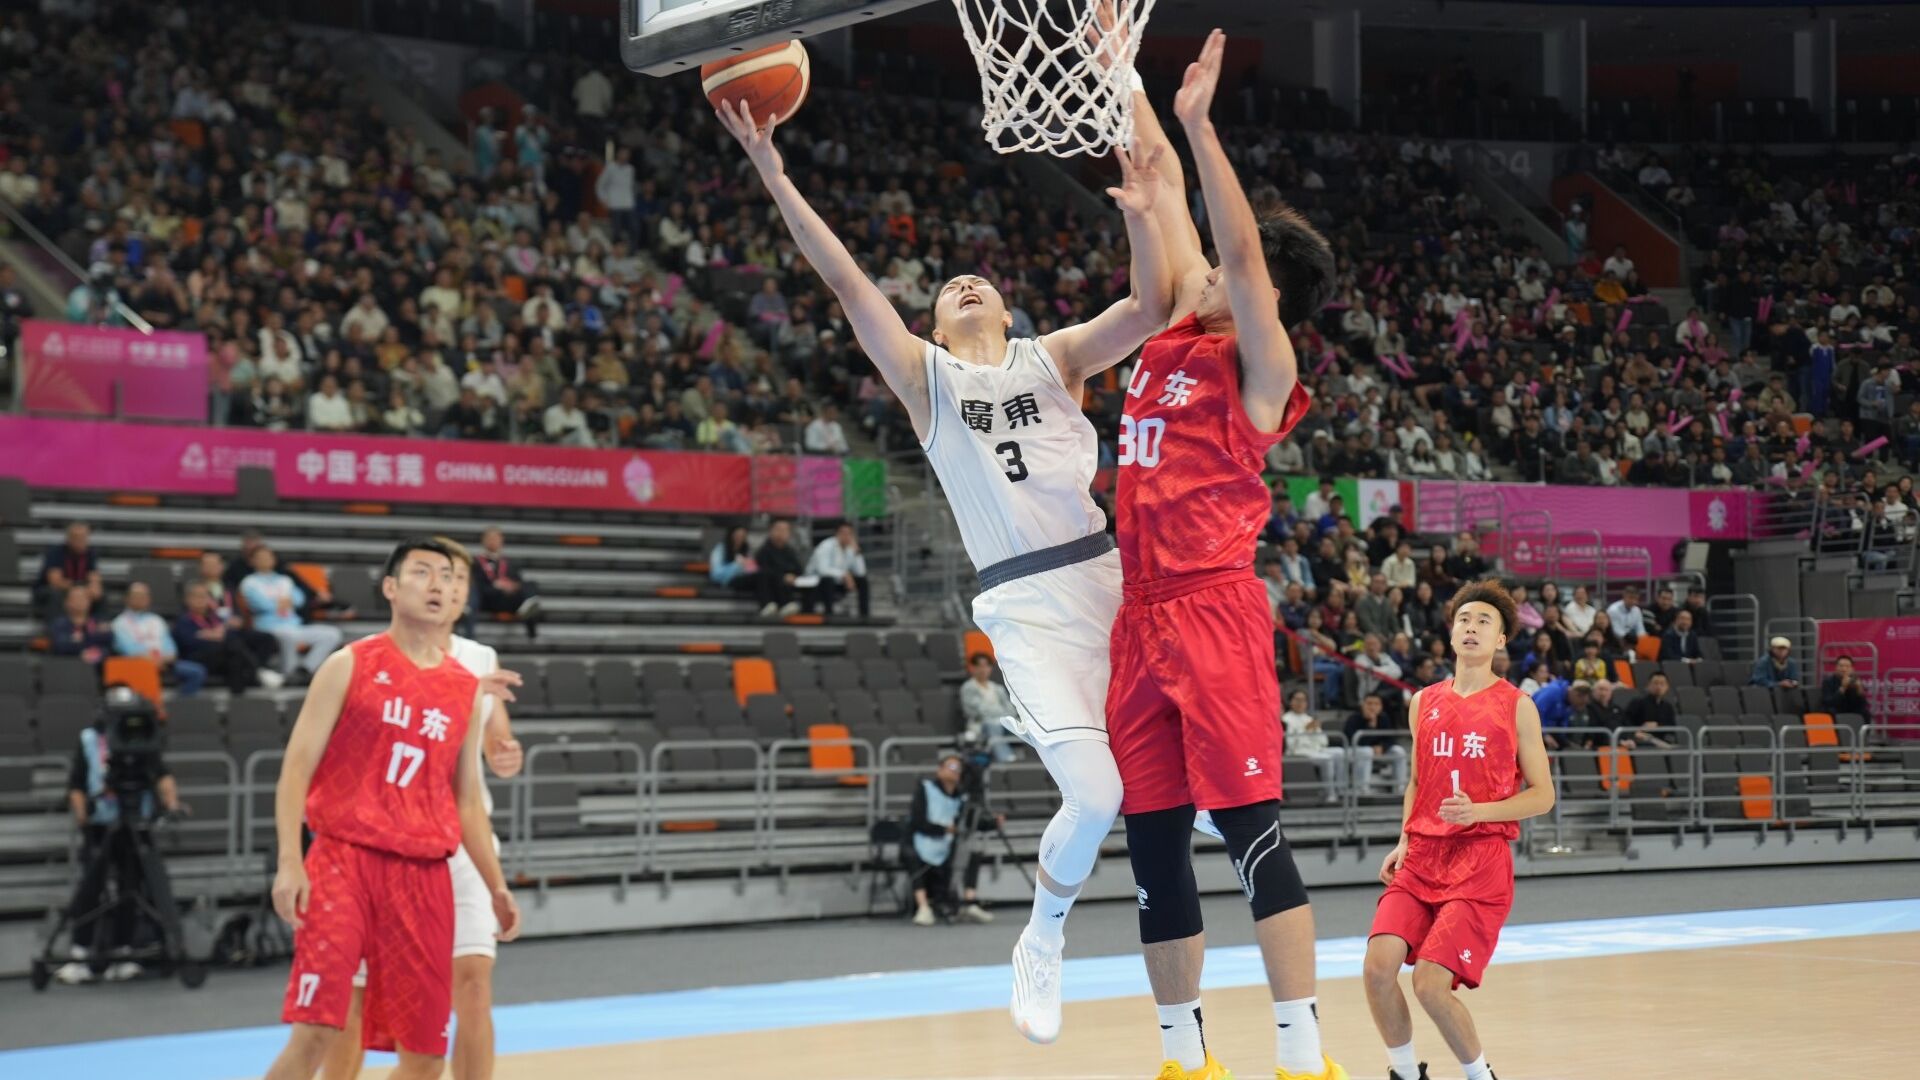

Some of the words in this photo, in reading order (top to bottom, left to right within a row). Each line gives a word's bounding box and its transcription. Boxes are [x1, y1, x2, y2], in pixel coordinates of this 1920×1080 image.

[1126, 359, 1198, 407] 山东
[961, 392, 1043, 434] 廣東
[995, 440, 1029, 483] 3
[1118, 414, 1166, 468] 30
[296, 449, 424, 486] 中国·东莞
[435, 461, 498, 483] CHINA
[503, 464, 608, 488] DONGGUAN
[382, 696, 452, 743] 山东
[384, 741, 425, 788] 17
[1433, 731, 1487, 759] 山东
[1450, 769, 1461, 797] 1
[296, 973, 321, 1008] 17
